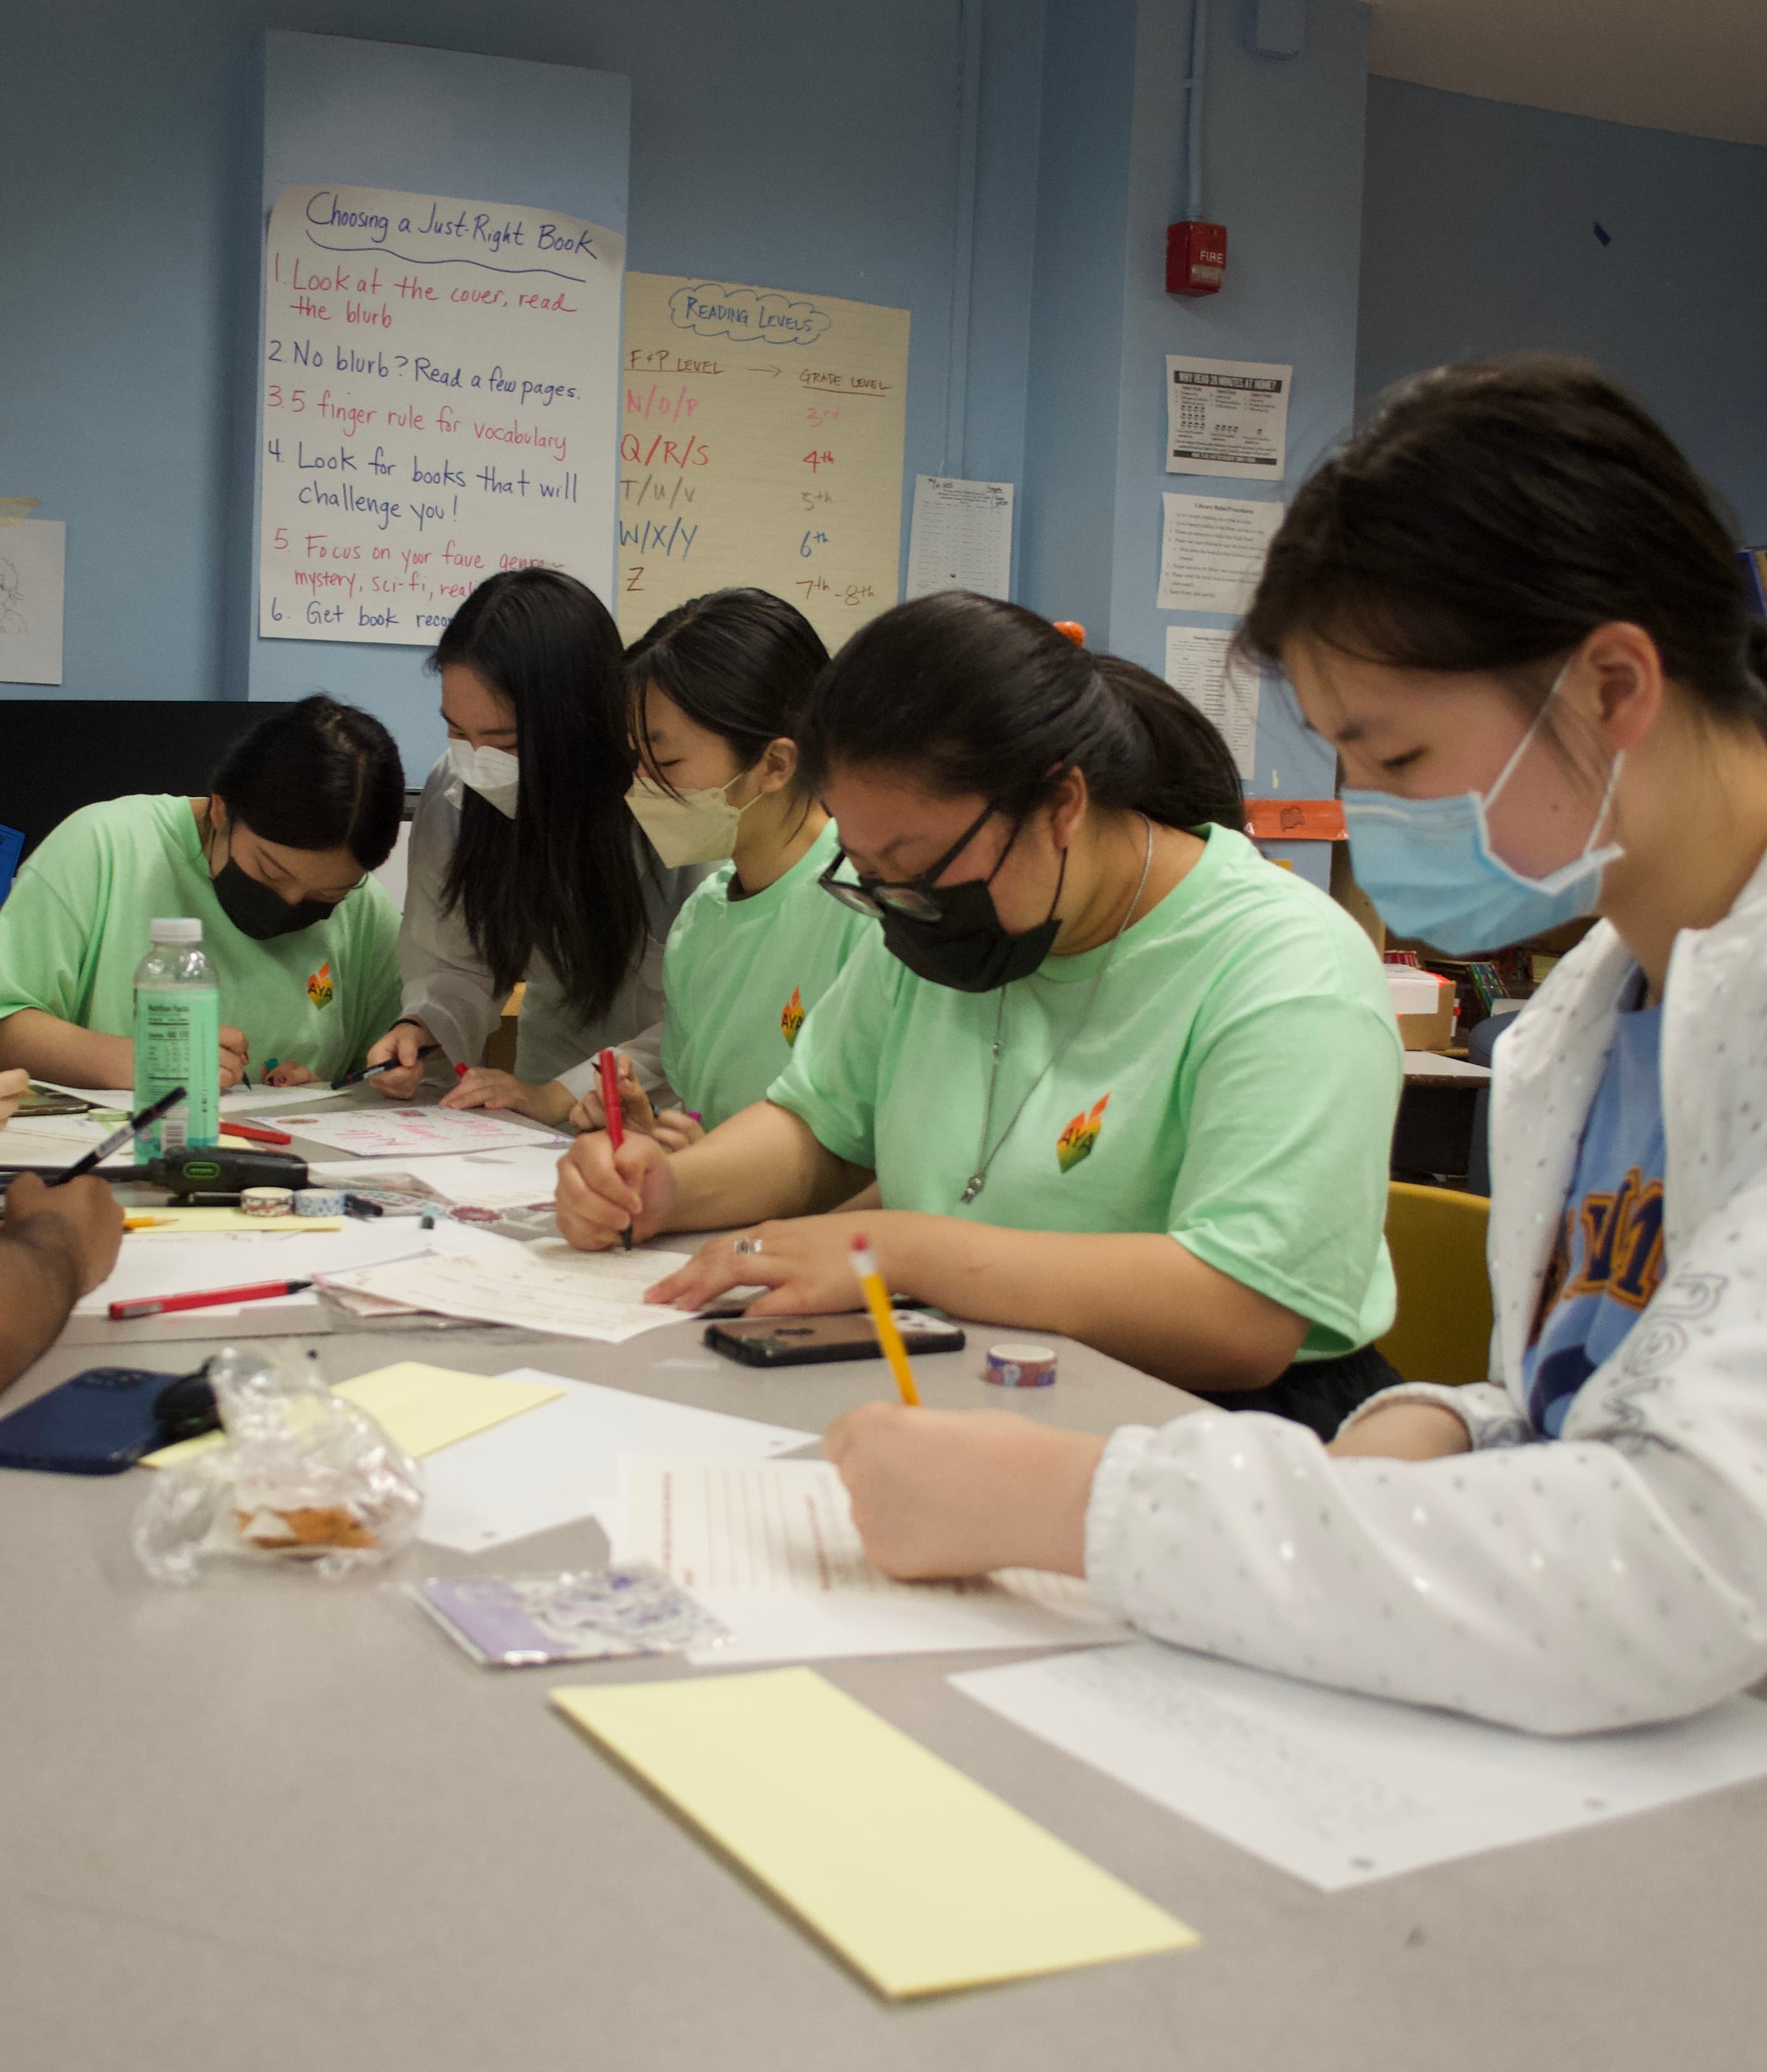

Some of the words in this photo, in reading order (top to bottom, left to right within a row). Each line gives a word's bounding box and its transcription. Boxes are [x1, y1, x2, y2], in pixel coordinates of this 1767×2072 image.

[306, 192, 388, 243] Choosing
[398, 219, 411, 232] a
[417, 203, 524, 252] Just-Right
[538, 224, 597, 259] Book
[1200, 250, 1223, 264] FIRE
[293, 257, 349, 291] Look
[357, 267, 382, 294] at
[394, 276, 439, 300] the
[451, 287, 508, 308] cover,
[519, 284, 577, 312] read
[290, 295, 332, 320] the
[346, 299, 393, 328] blurb
[686, 296, 748, 325] READING
[759, 306, 813, 332] LEVELS
[293, 339, 323, 367] No
[415, 356, 462, 388] Read
[471, 374, 481, 388] a
[489, 366, 518, 392] few
[521, 379, 581, 406] pages.
[677, 358, 725, 373] LEVEL
[799, 368, 843, 386] GRADE
[851, 378, 893, 389] LEVEL
[626, 384, 698, 422] N/O/P
[806, 406, 841, 427] 3rd
[292, 390, 306, 412] 5
[318, 389, 377, 436] finger
[388, 405, 425, 430] rule
[436, 405, 462, 433] for
[474, 419, 567, 461] vocabulary
[620, 433, 709, 469] Q/R/S
[803, 450, 834, 473] 4th
[299, 441, 357, 470] Look
[368, 446, 396, 475] for
[412, 455, 466, 487] books
[476, 465, 530, 497] that
[541, 472, 577, 502] will
[299, 480, 401, 530] challenge
[411, 495, 457, 531] you!
[802, 492, 833, 511] 5th
[304, 534, 361, 560] Focus
[372, 546, 391, 562] on
[402, 551, 432, 572] your
[442, 540, 485, 570] fave
[619, 516, 697, 560] W/X/Y
[800, 530, 830, 557] 6th
[294, 568, 364, 599] mystery,
[372, 571, 434, 601] sci-fi,
[440, 577, 480, 597] real
[626, 567, 644, 591] Z
[307, 602, 344, 625] Get
[359, 607, 400, 628] book
[416, 614, 452, 628] reco
[307, 983, 333, 1000] AYA
[1060, 1127, 1094, 1154] AYA
